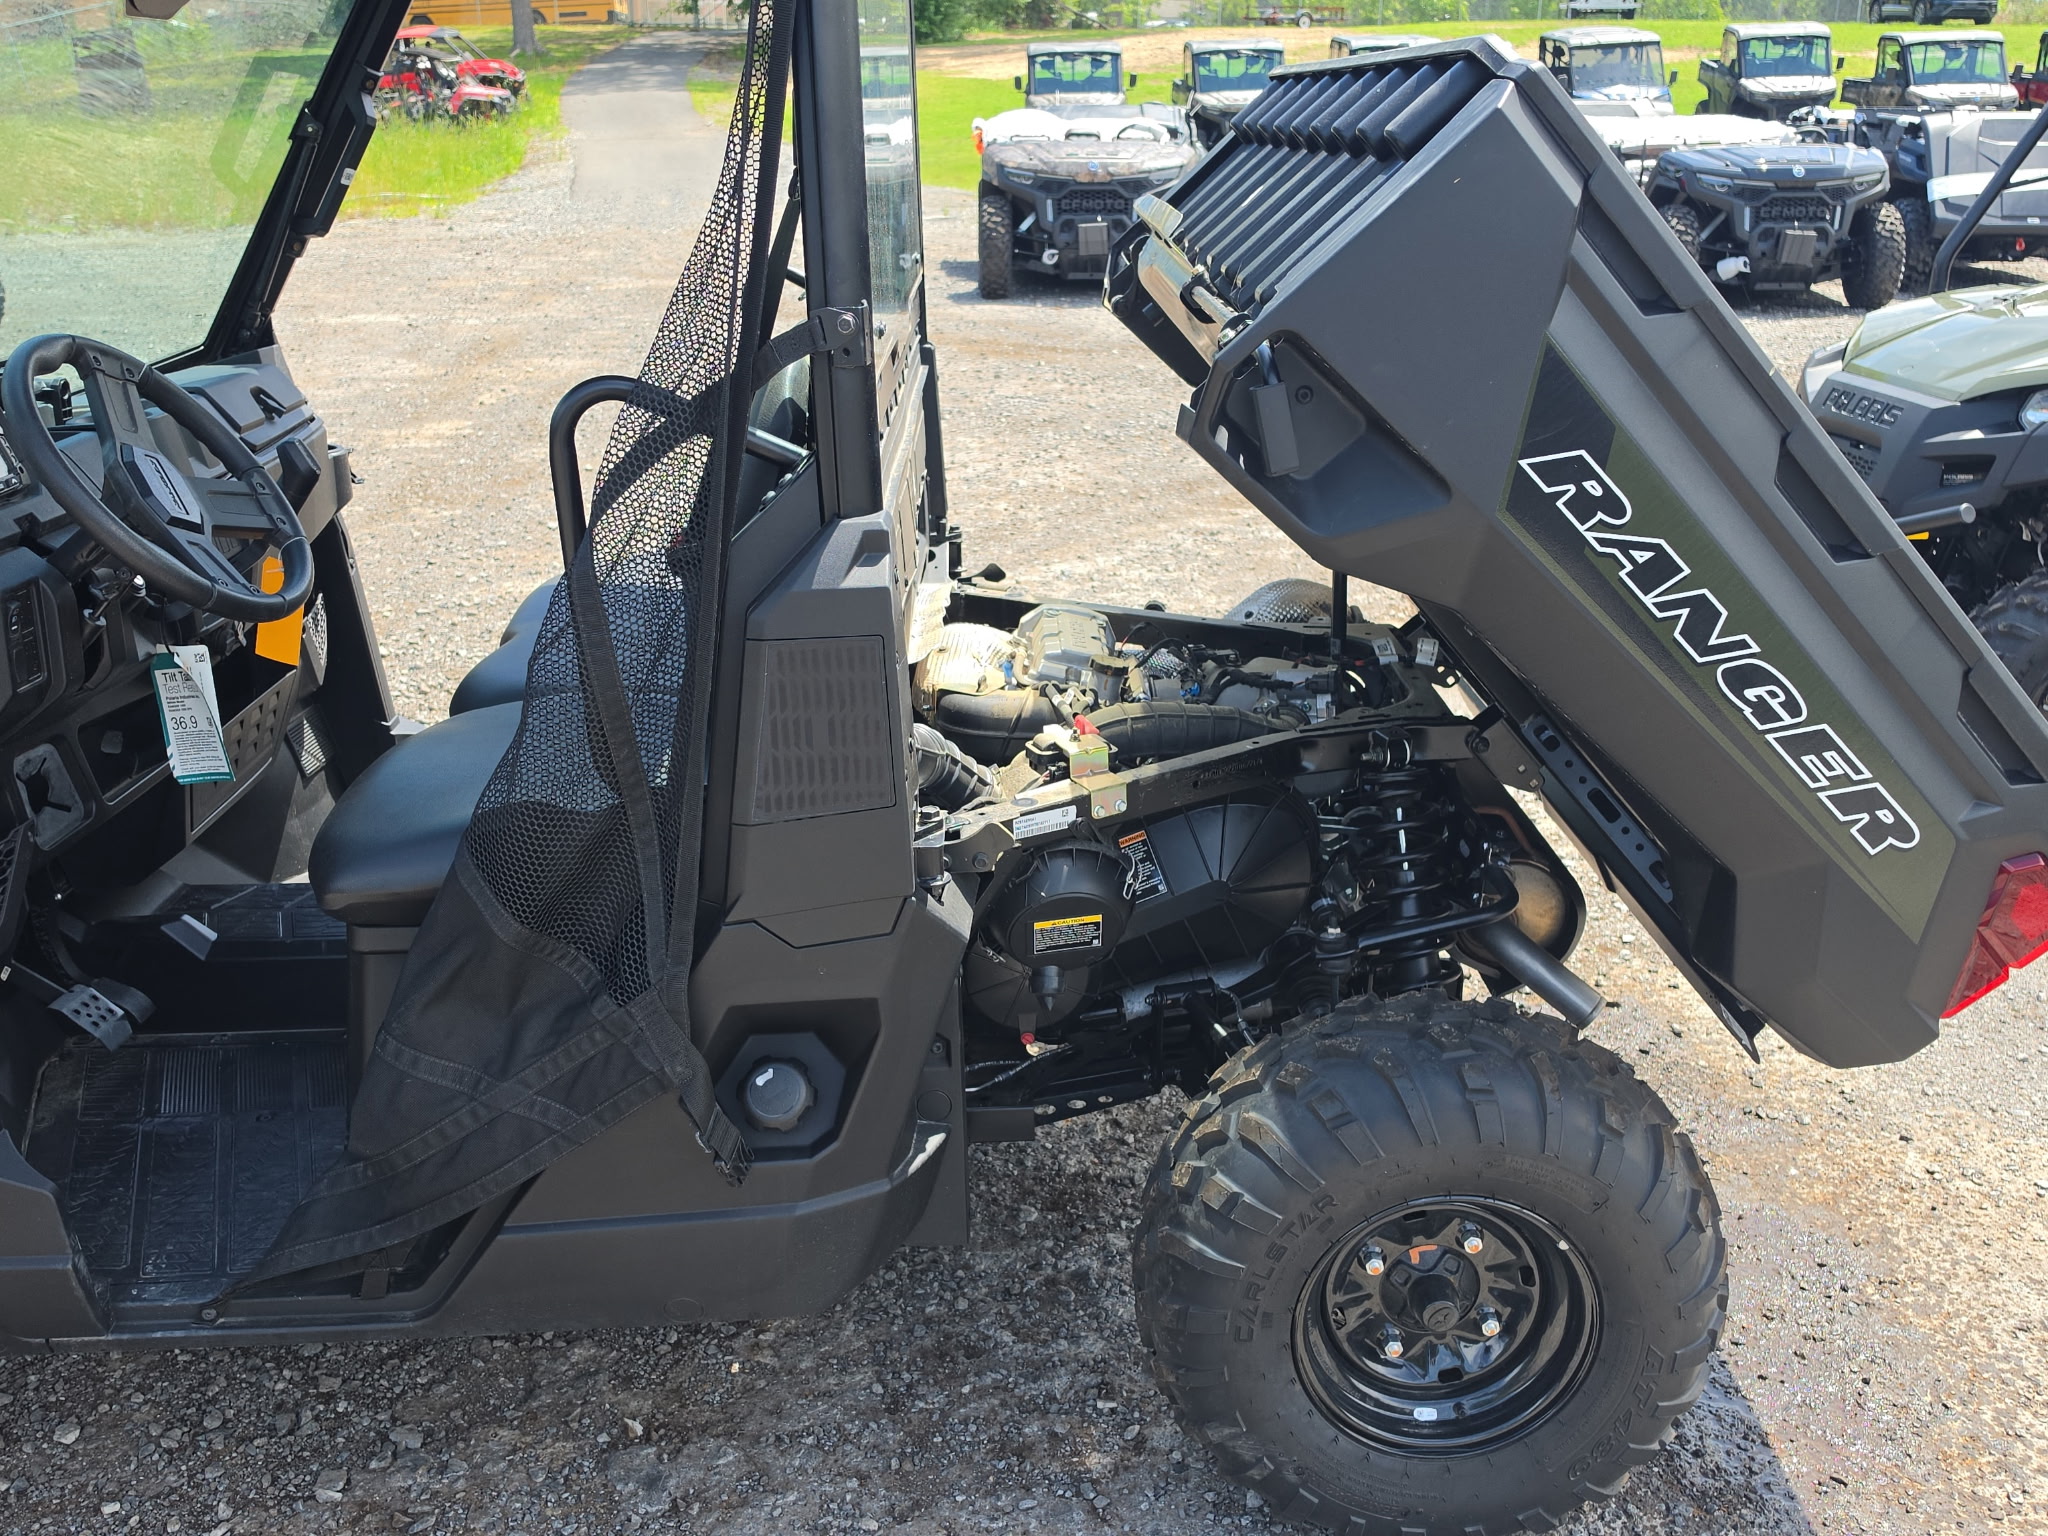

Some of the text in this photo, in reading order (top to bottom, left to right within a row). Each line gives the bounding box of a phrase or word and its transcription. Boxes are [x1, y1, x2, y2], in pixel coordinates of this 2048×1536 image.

[1061, 199, 1126, 210] CFMOTO
[1761, 204, 1827, 218] CFMOTO
[1822, 387, 1905, 429] POLARIS
[1517, 448, 1922, 857] RANGER
[161, 671, 178, 683] Tilt
[162, 683, 182, 694] Test
[170, 715, 198, 730] 36.9
[1120, 831, 1146, 846] WARNING
[1233, 1193, 1341, 1343] CARLSTAR
[1568, 1344, 1665, 1481] AT489
